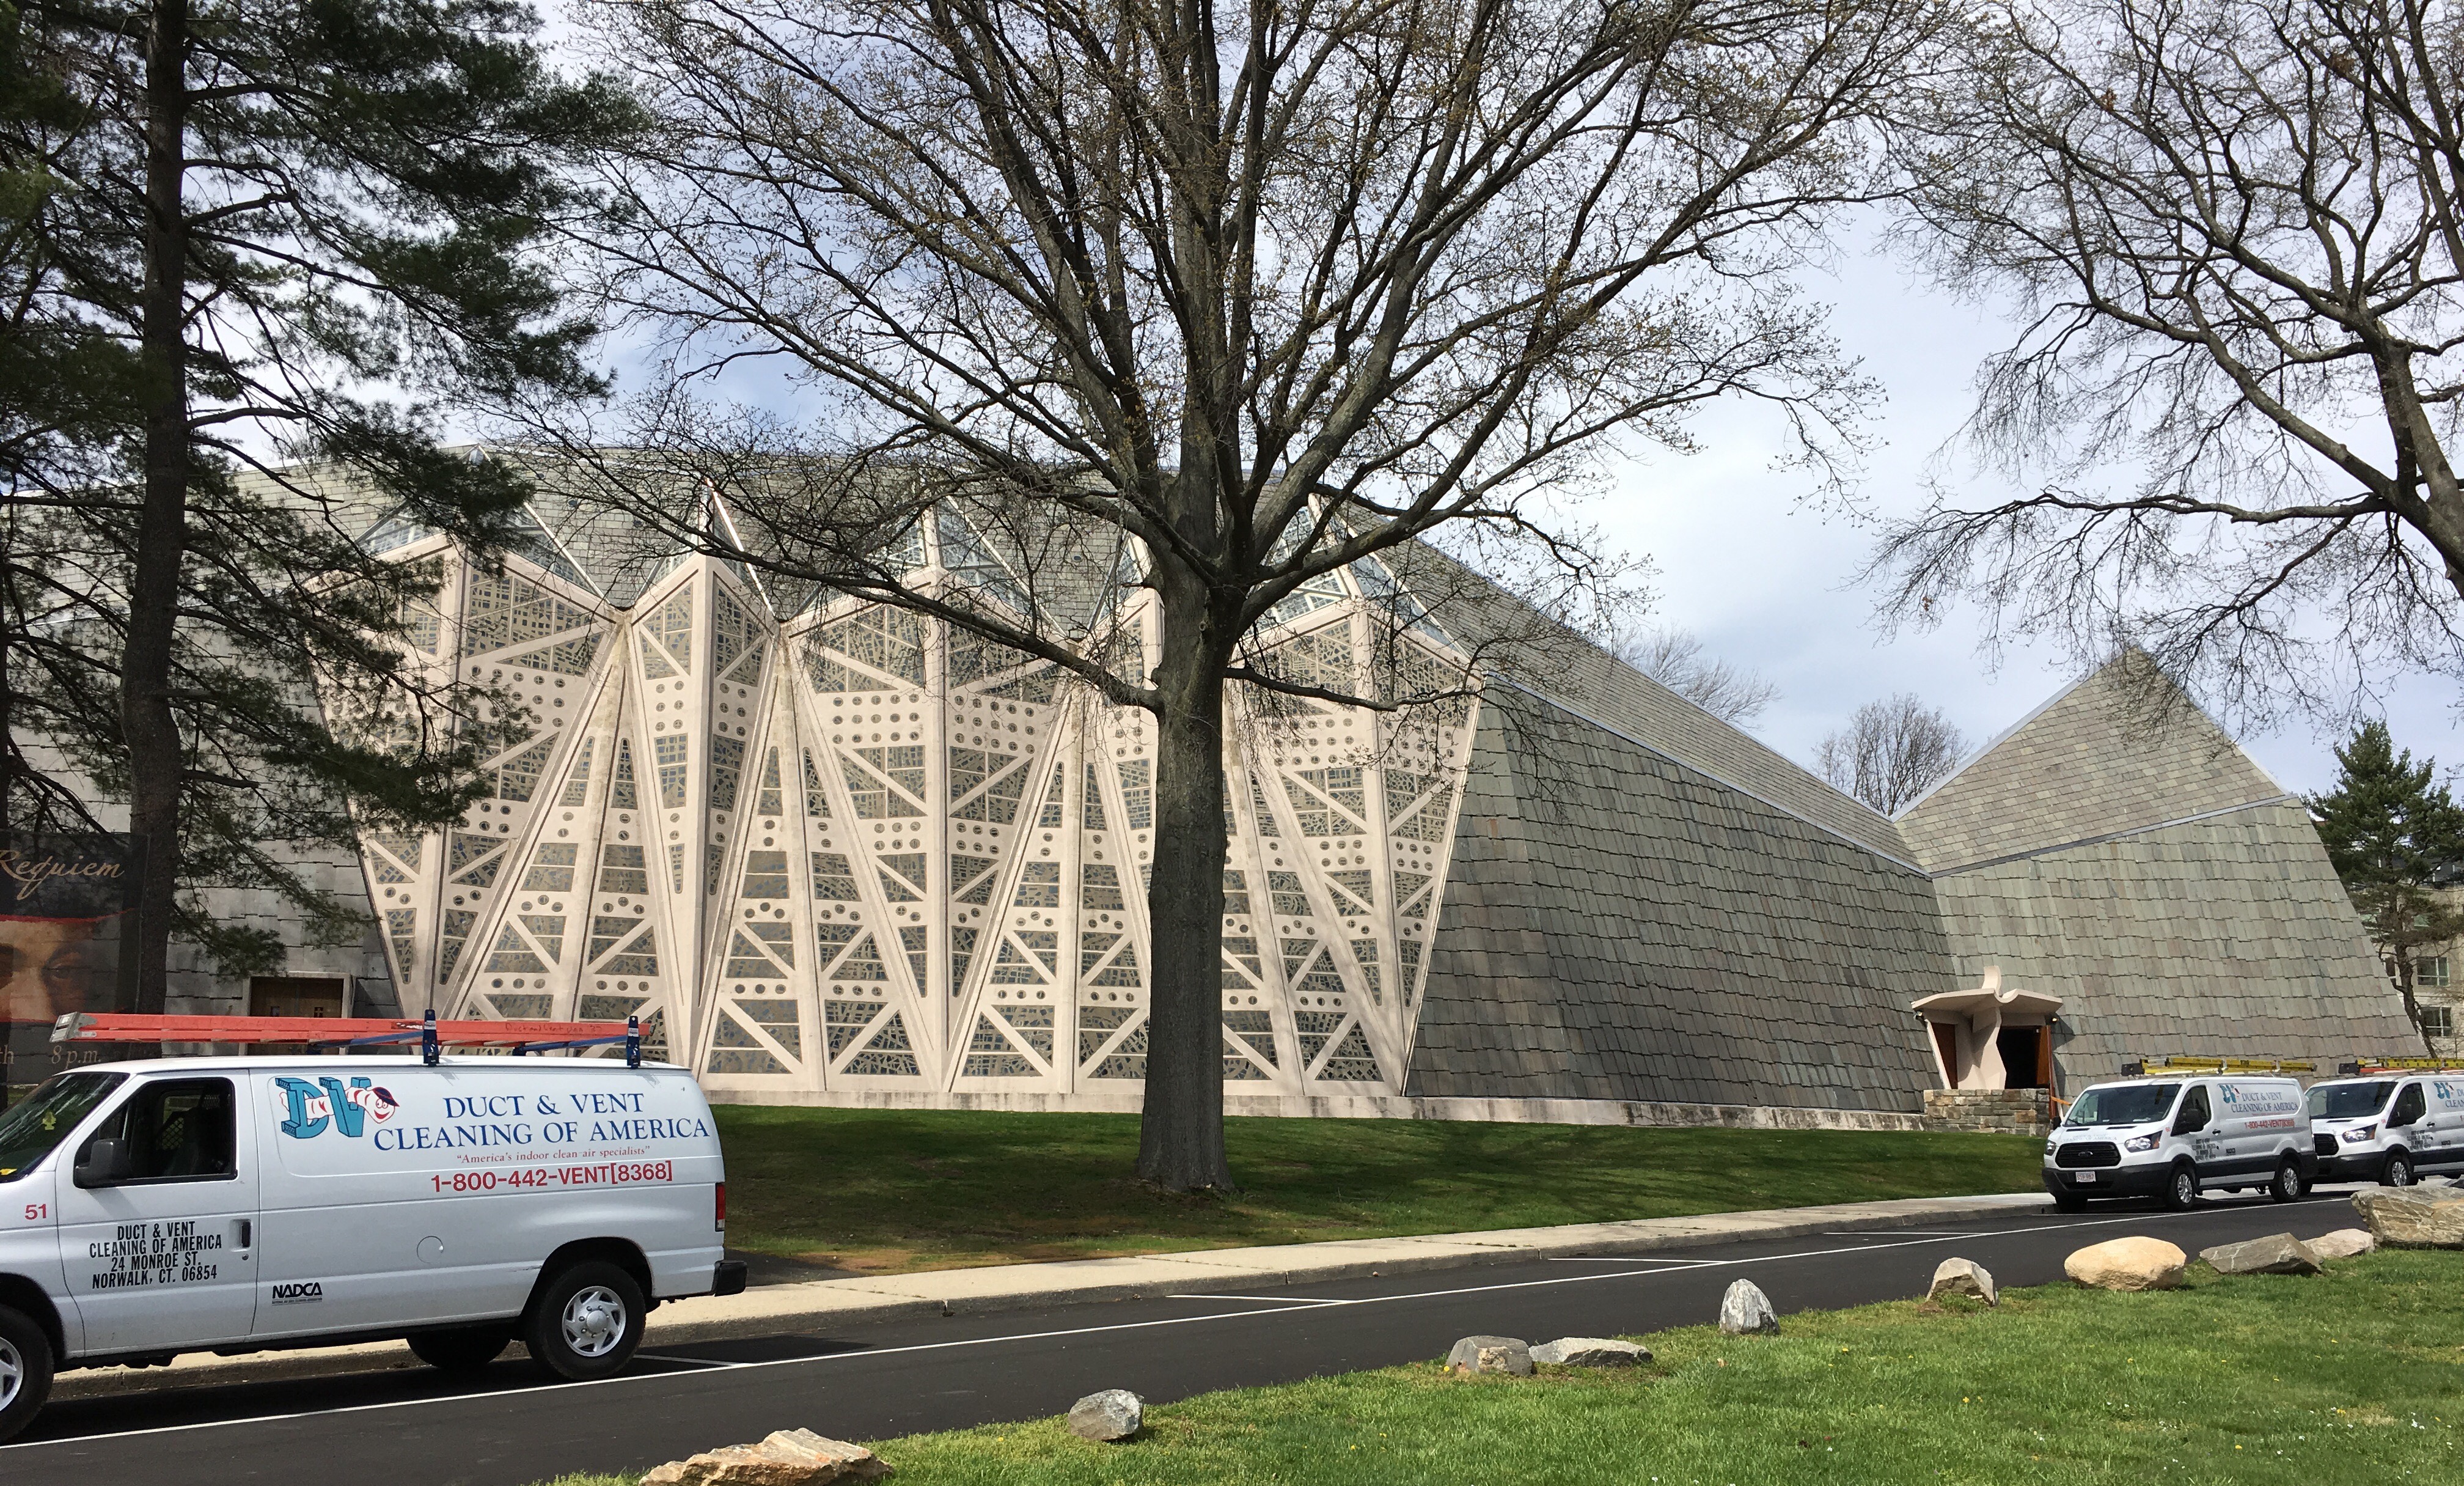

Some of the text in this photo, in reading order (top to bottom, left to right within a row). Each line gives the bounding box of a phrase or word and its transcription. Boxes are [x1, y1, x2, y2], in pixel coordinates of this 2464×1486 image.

[0, 850, 125, 900] Requiem
[51, 1045, 62, 1064] 8
[64, 1050, 101, 1070] p.m.
[442, 1093, 644, 1118] DUCT & VENT
[2231, 1102, 2298, 1113] CLEANING OF AMERICA
[2241, 1092, 2260, 1102] DUCT
[2267, 1092, 2282, 1100] VENT
[374, 1118, 710, 1150] CLEANING OF AMERICA
[516, 1150, 549, 1161] indoor
[431, 1160, 673, 1193] 1-800-442-VENT[8368]
[24, 1204, 46, 1220] 51
[117, 1221, 196, 1241] DUCT & VENT
[89, 1234, 222, 1258] CLEANING OF AMERICA
[111, 1251, 201, 1272] 24 MONROE ST.
[92, 1265, 217, 1289] NORWALK, CT. 06854
[273, 1282, 322, 1298] NADCA
